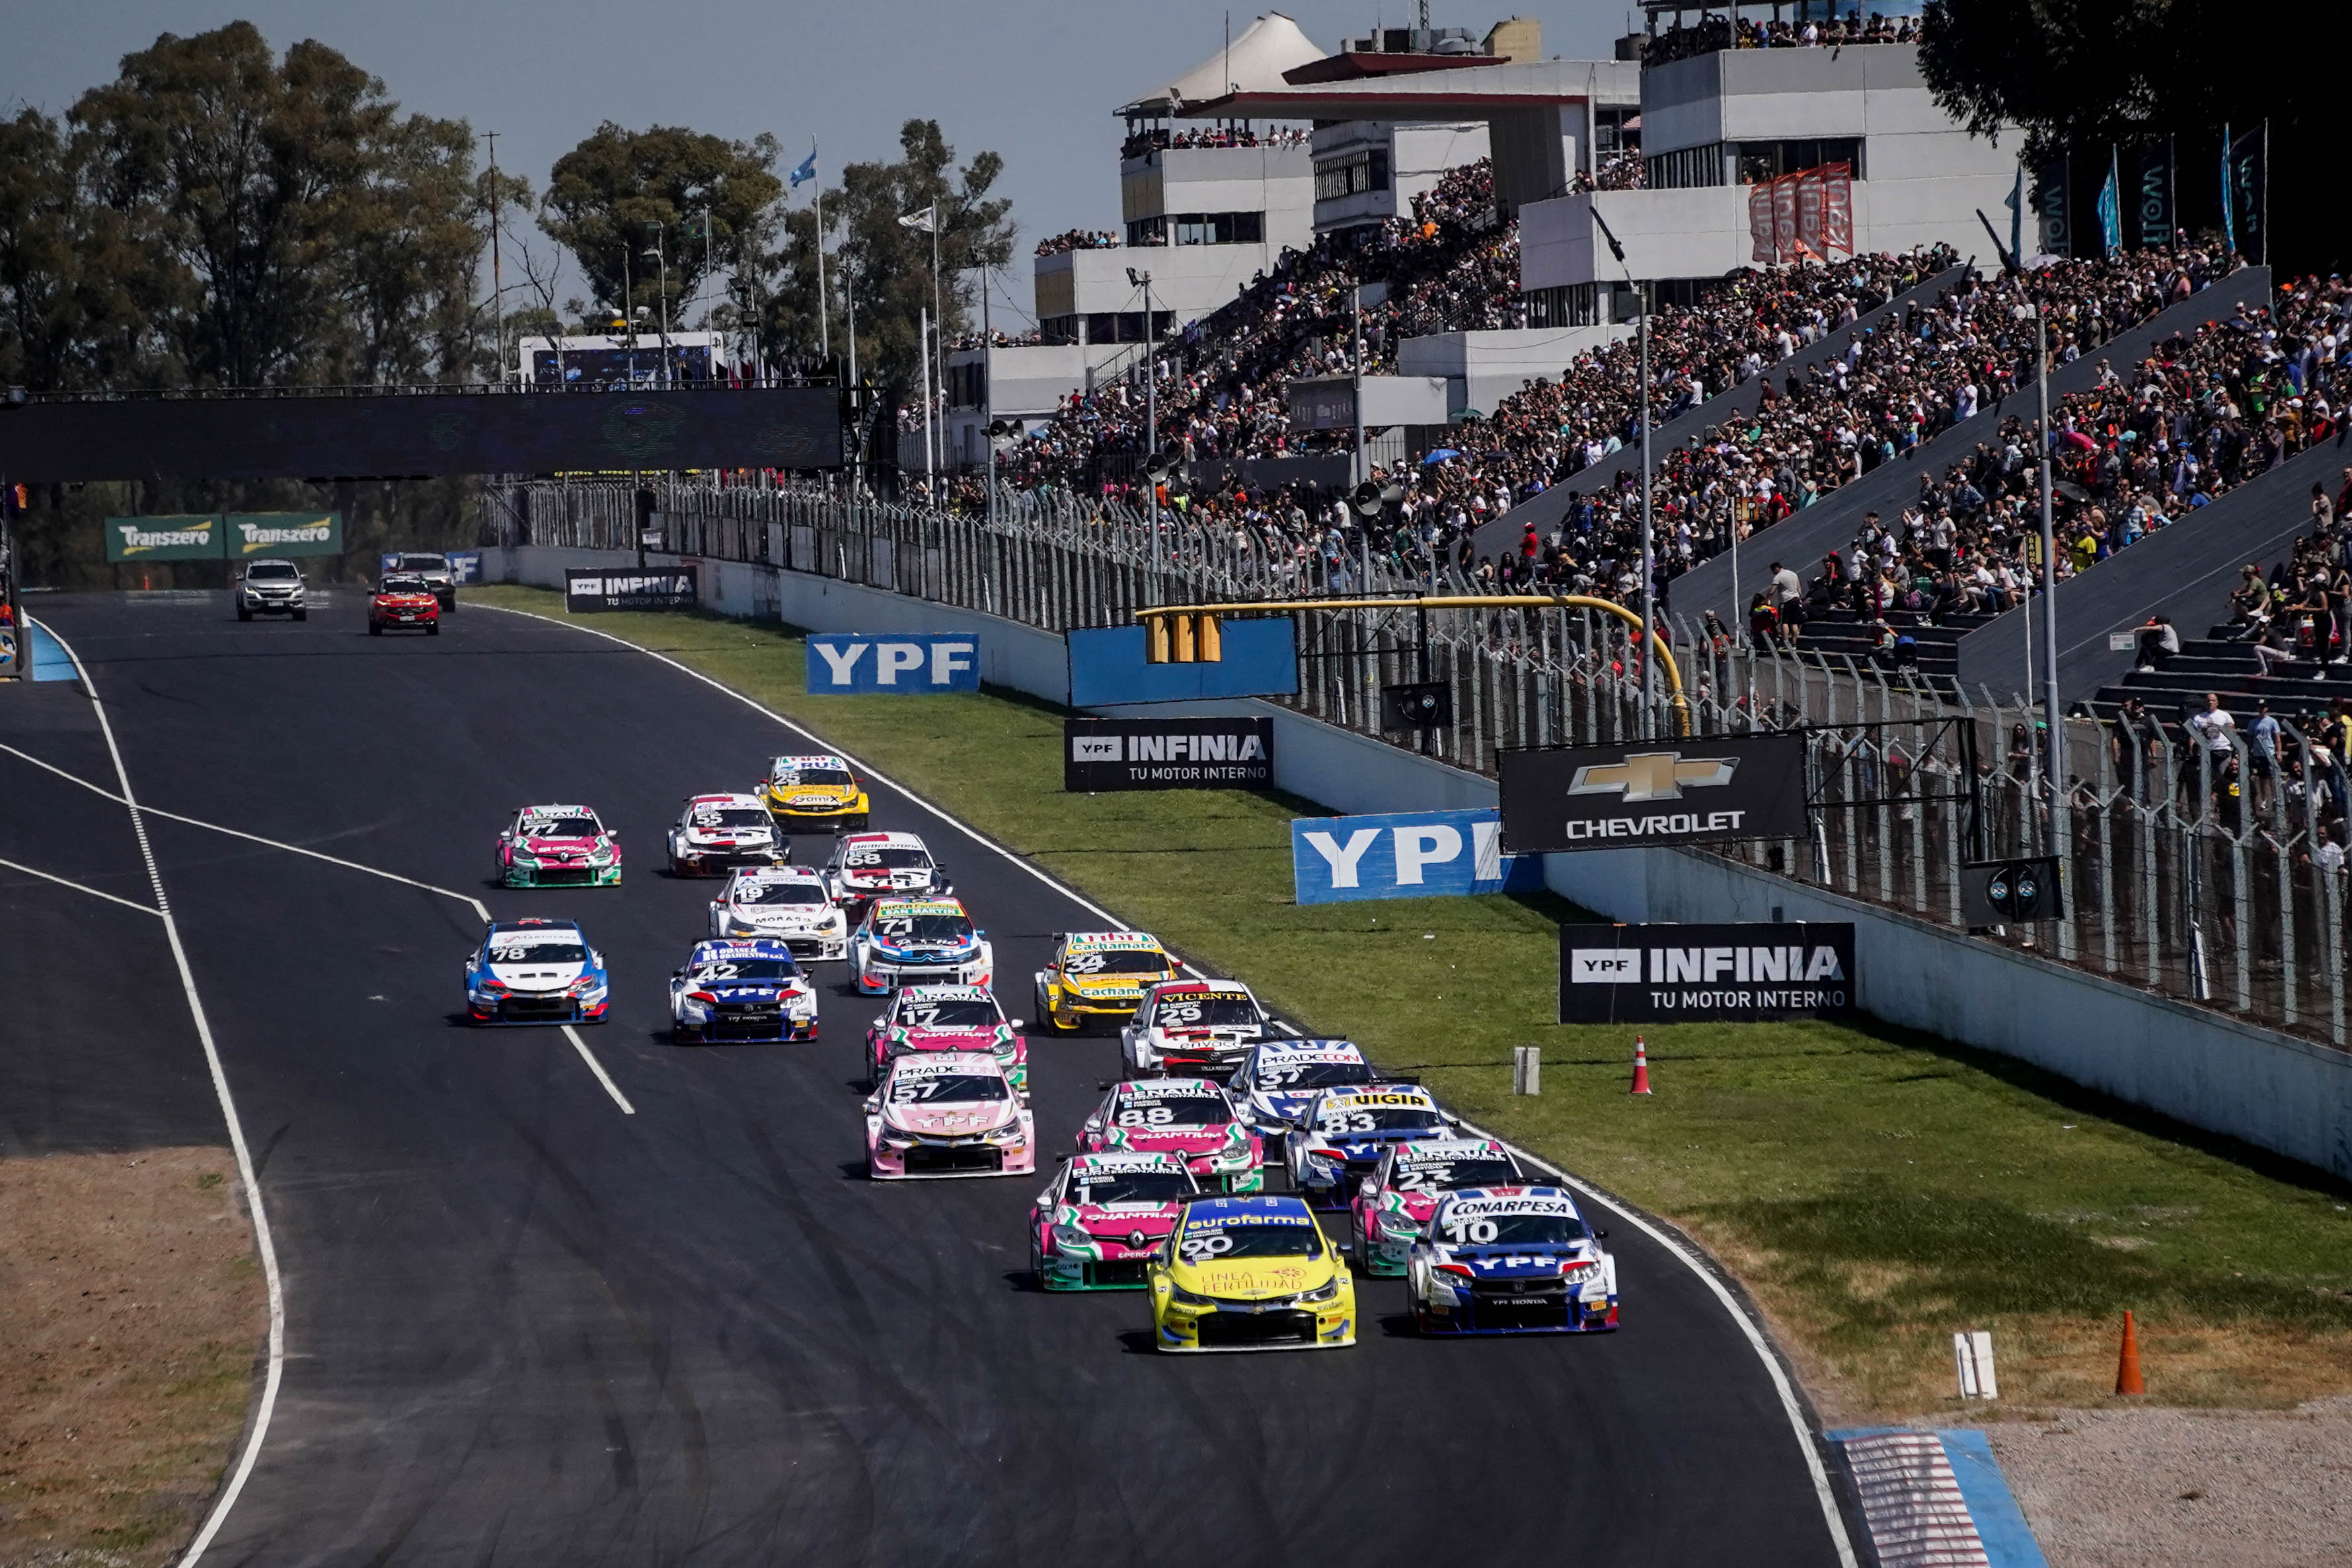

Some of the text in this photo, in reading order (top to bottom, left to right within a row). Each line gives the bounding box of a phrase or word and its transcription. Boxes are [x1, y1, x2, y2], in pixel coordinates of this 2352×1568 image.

[119, 525, 209, 546] Transzero
[239, 523, 330, 543] Transzero
[605, 576, 693, 595] INFINIA
[814, 642, 973, 685] YPF
[1082, 745, 1113, 753] YPF
[1129, 735, 1267, 762] INFINIA
[774, 772, 800, 786] 25
[1129, 767, 1267, 780] TU MOTOR INTERNO
[697, 813, 723, 825] 55
[1567, 810, 1746, 840] CHEVROLET
[523, 823, 559, 837] 77
[847, 854, 882, 866] 68
[736, 887, 764, 899] 19
[878, 918, 913, 935] 71
[492, 948, 526, 961] 78
[1066, 955, 1106, 973] 34
[1583, 959, 1629, 971] YPF
[1650, 946, 1845, 983] INFINIA
[695, 965, 739, 980] 42
[716, 988, 776, 998] YPF
[901, 993, 991, 1004] RENAULT
[1162, 992, 1248, 1002] VICENTE
[1651, 991, 1845, 1008] TU MOTOR INTERNO
[901, 1008, 940, 1025] 17
[1159, 1008, 1202, 1024] 29
[1263, 1054, 1359, 1065] PRADECON
[899, 1066, 996, 1078] PRADECON
[1259, 1067, 1303, 1086] 37
[893, 1082, 940, 1101] 57
[1119, 1088, 1221, 1102] RENAULT
[1356, 1094, 1426, 1106] VIGIA
[912, 1115, 990, 1129] YPF
[1119, 1107, 1174, 1127] 88
[1325, 1113, 1376, 1134] 83
[1396, 1150, 1507, 1164] RENAULT
[1073, 1163, 1182, 1178] RENAULT
[1396, 1169, 1453, 1191] 23
[1074, 1186, 1090, 1205] 1
[1453, 1201, 1567, 1215] CONARPESA
[1188, 1214, 1310, 1230] eurofarma
[1445, 1220, 1499, 1244] 10
[1180, 1235, 1234, 1255] 90
[1476, 1257, 1557, 1270] YPF
